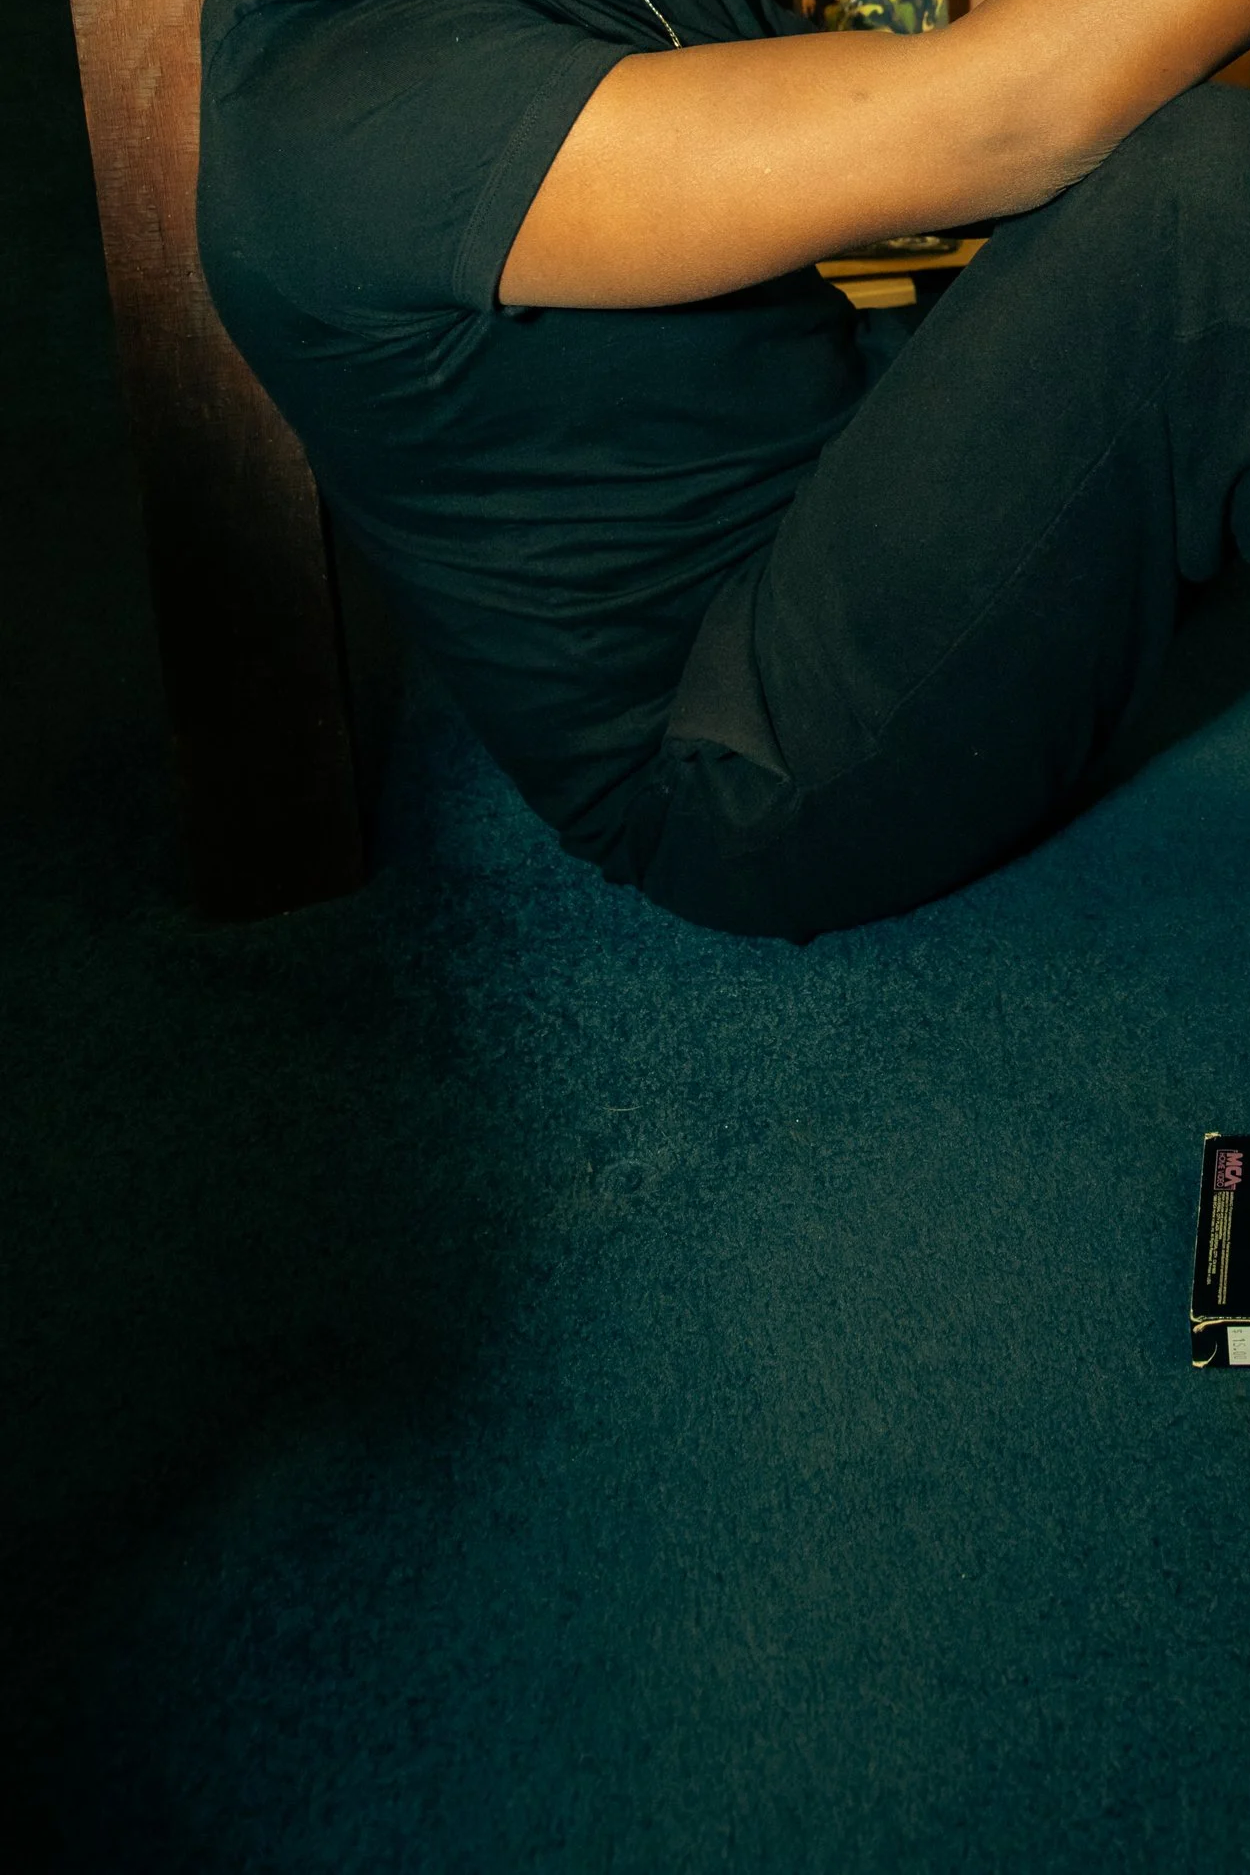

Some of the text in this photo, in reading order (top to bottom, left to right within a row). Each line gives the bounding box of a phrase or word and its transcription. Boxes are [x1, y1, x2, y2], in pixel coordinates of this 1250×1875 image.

[1216, 1152, 1225, 1187] HOME VIDEO
[1224, 1151, 1243, 1187] MCA
